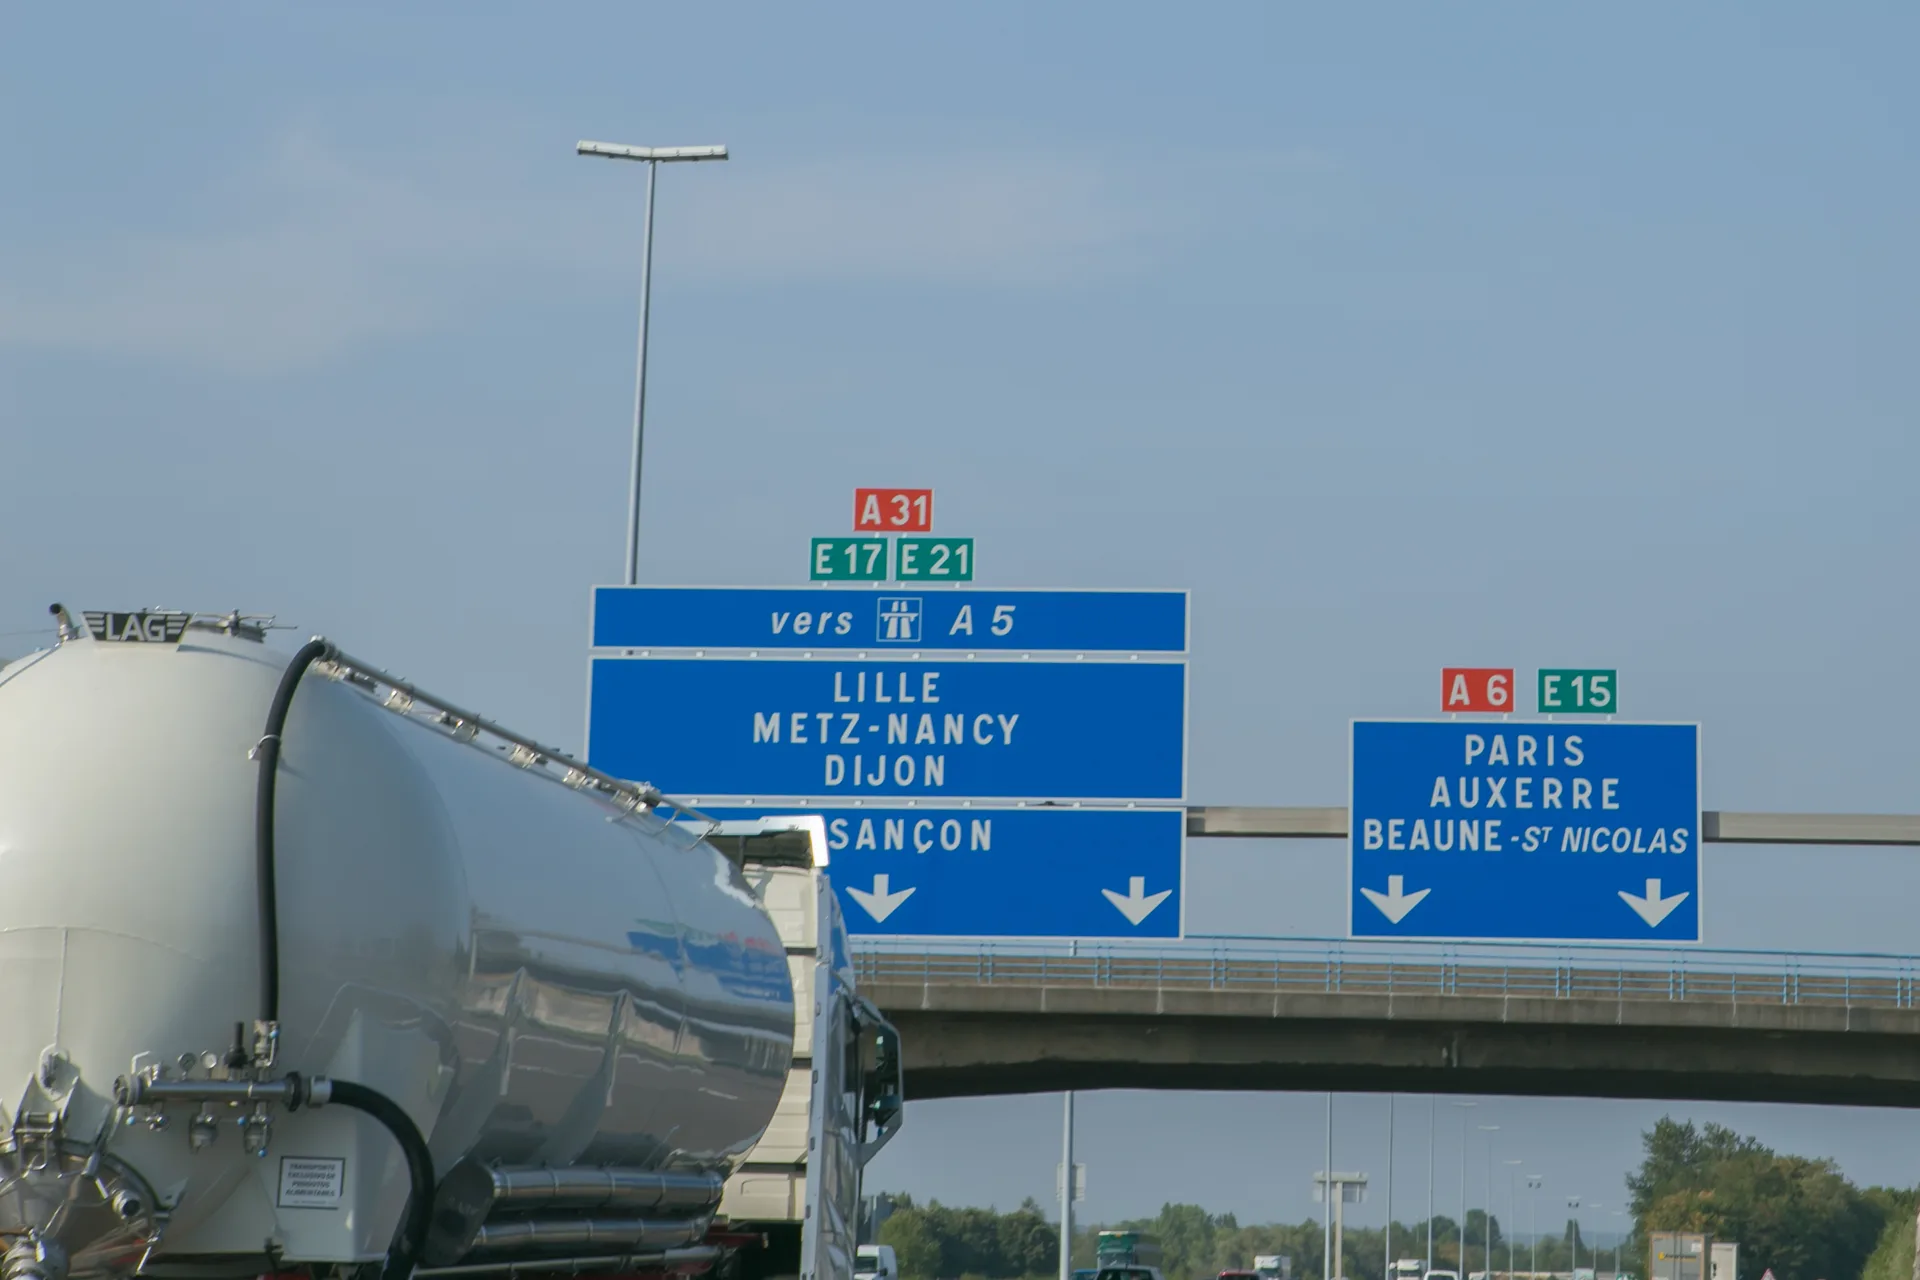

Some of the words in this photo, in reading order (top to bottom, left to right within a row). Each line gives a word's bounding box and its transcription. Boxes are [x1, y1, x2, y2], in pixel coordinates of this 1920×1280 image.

[861, 495, 881, 524] A
[890, 494, 926, 525] 31
[816, 543, 833, 574] E
[845, 543, 882, 574] 17
[902, 544, 918, 575] E
[929, 544, 968, 575] 21
[106, 613, 166, 642] LAG
[772, 611, 853, 635] vers
[949, 605, 973, 635] A
[991, 605, 1016, 636] 5
[834, 671, 940, 703] LILLE
[1449, 675, 1469, 705] A
[1487, 675, 1507, 705] 6
[1544, 675, 1561, 706] E
[1571, 675, 1611, 707] 15
[753, 712, 1019, 745] METZ-NANCY
[1465, 734, 1584, 766] PARIS
[825, 754, 944, 786] DIJON
[1430, 776, 1619, 809] AUXERRE
[828, 818, 991, 854] SANÇON
[1561, 827, 1689, 854] NICOLAS
